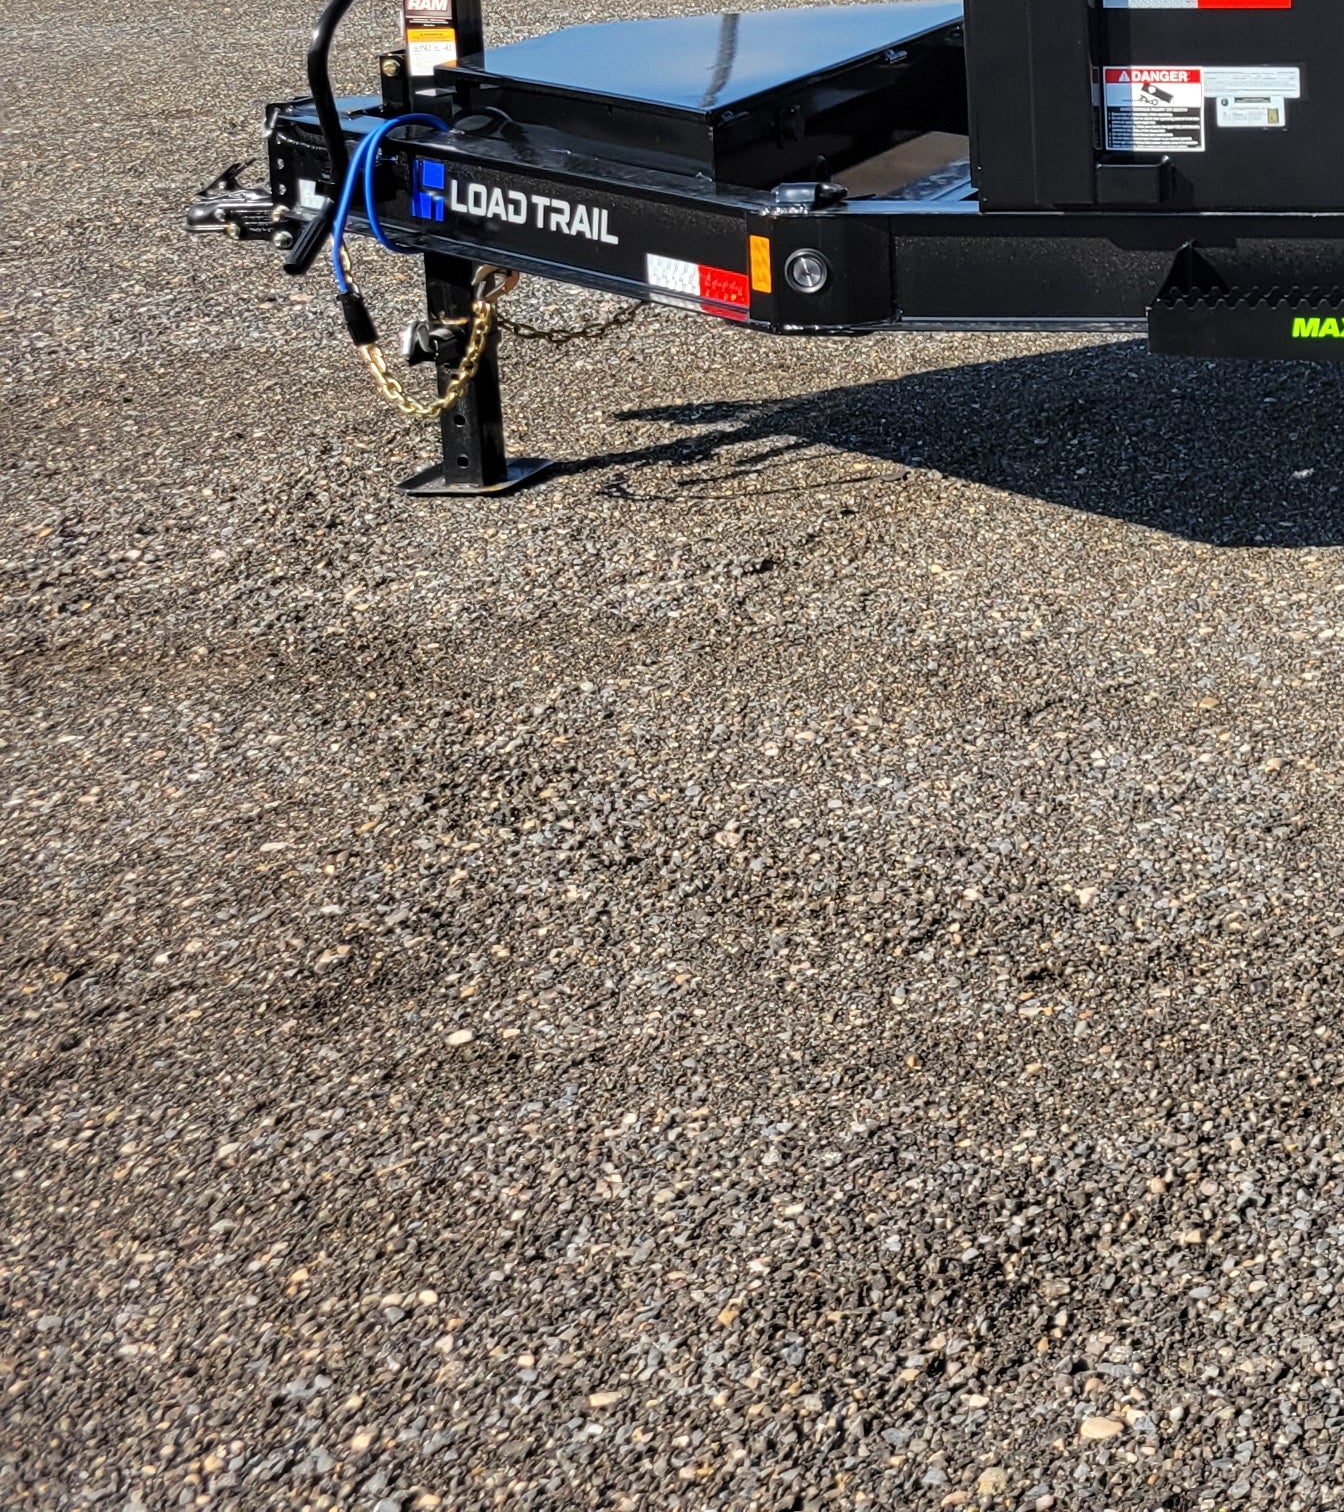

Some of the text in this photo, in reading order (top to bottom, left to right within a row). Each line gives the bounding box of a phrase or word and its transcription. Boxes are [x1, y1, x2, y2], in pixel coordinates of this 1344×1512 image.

[1131, 71, 1189, 82] DANGER
[450, 179, 619, 245] LOAD TRAIL
